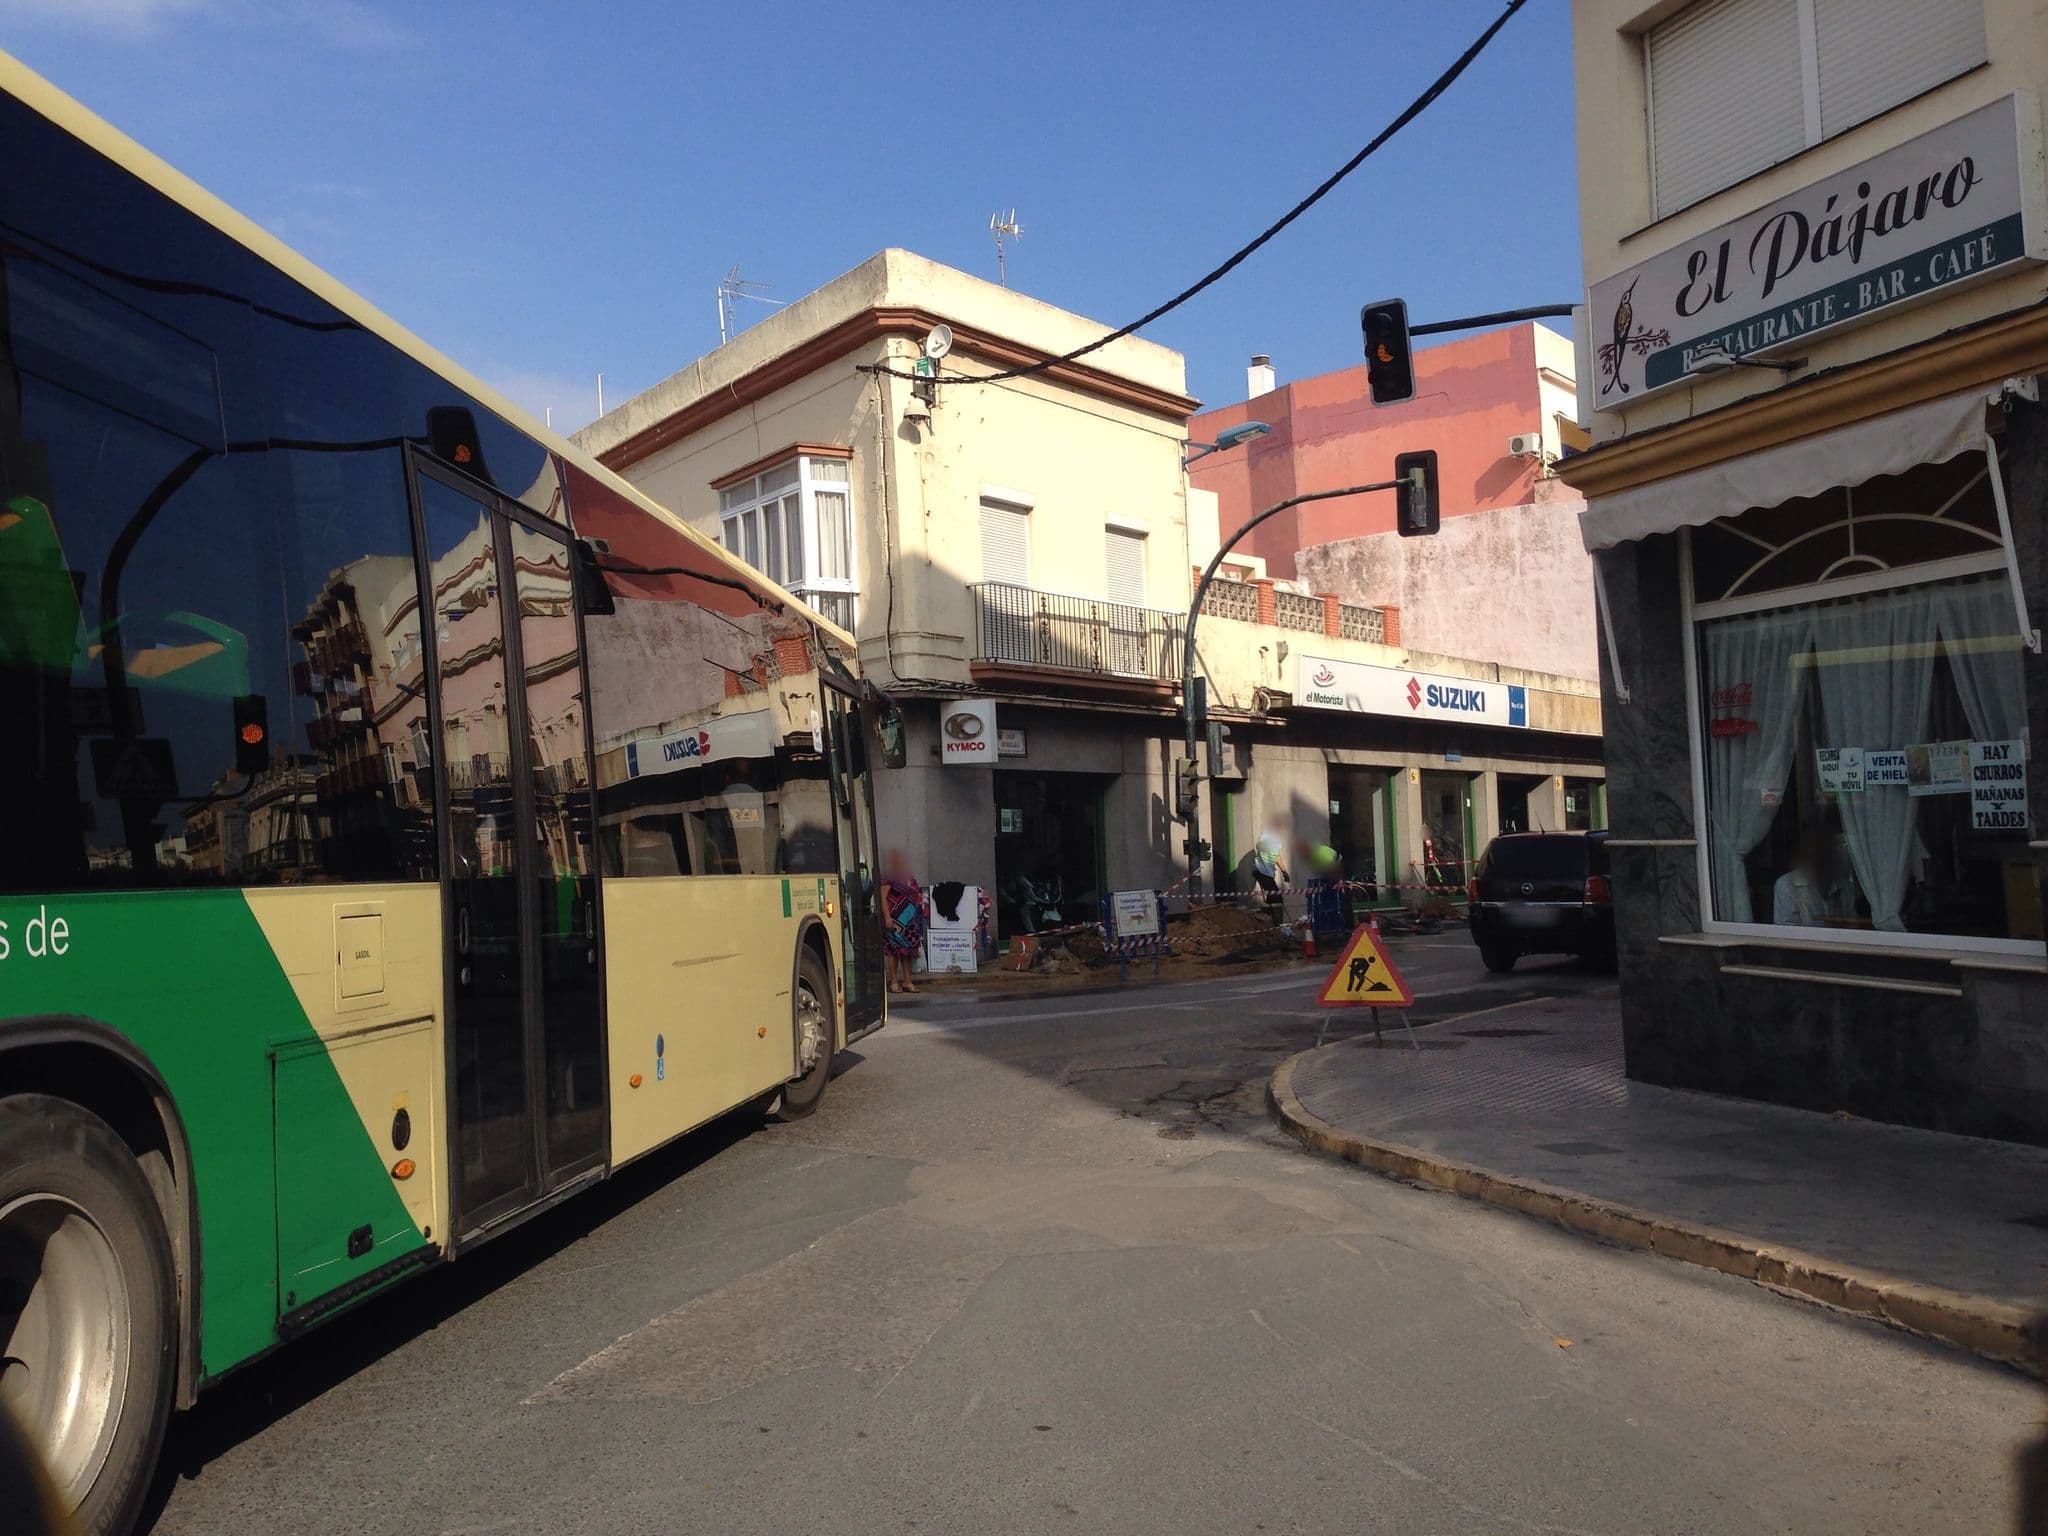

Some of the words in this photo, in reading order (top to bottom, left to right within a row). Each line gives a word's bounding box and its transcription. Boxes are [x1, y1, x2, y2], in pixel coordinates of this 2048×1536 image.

[1675, 239, 1733, 317] El
[1748, 157, 1984, 300] Pájaro
[1858, 269, 1906, 309] BAR
[1929, 231, 1996, 283] CAFÉ
[1426, 684, 1486, 712] SUZUKI
[946, 741, 985, 752] KYMCO
[1982, 745, 2010, 760] HAY
[1871, 756, 1906, 767] VENTA
[1867, 771, 1879, 780] DE
[1974, 764, 2022, 781] CHURROS
[1975, 785, 2025, 801] MAÑANAS
[1976, 811, 2026, 827] TARDES
[25, 904, 70, 957] de
